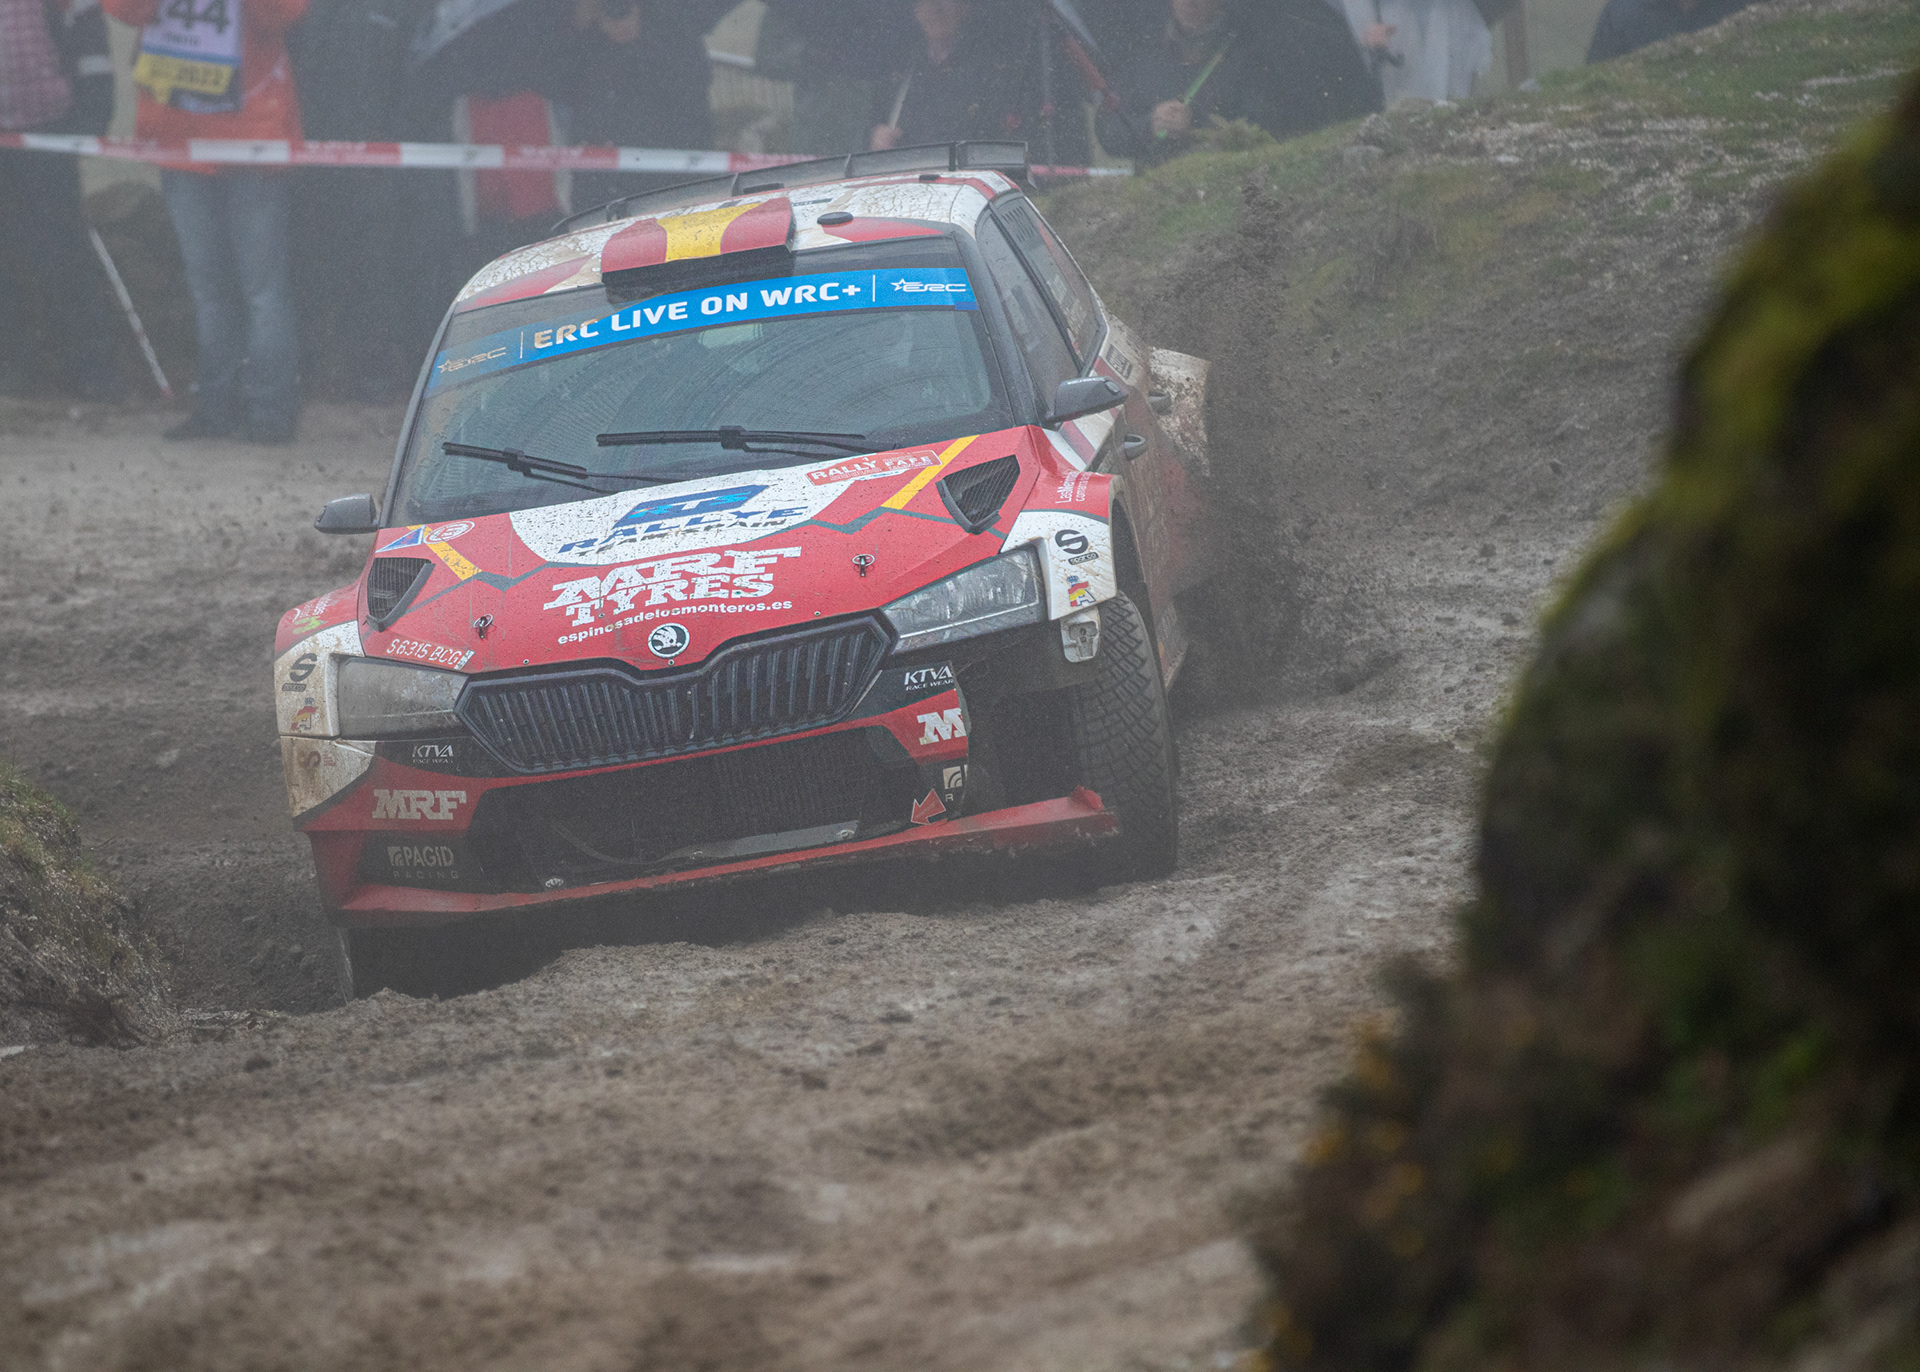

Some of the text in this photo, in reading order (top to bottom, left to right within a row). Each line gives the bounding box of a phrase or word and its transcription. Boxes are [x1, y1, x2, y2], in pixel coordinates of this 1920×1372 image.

[533, 282, 862, 349] ERC LIVE ON WRC+
[810, 459, 877, 480] RALLY
[557, 505, 809, 554] RALLYE
[543, 545, 802, 611] MRF
[565, 572, 775, 627] TYRES
[557, 600, 793, 645] espinosadelosmonteros.es
[428, 646, 462, 665] BCG
[904, 665, 953, 686] KTVA
[412, 744, 454, 758] KTVA
[372, 788, 467, 820] MRF
[402, 845, 454, 868] PAGID
[393, 870, 460, 880] RACING
